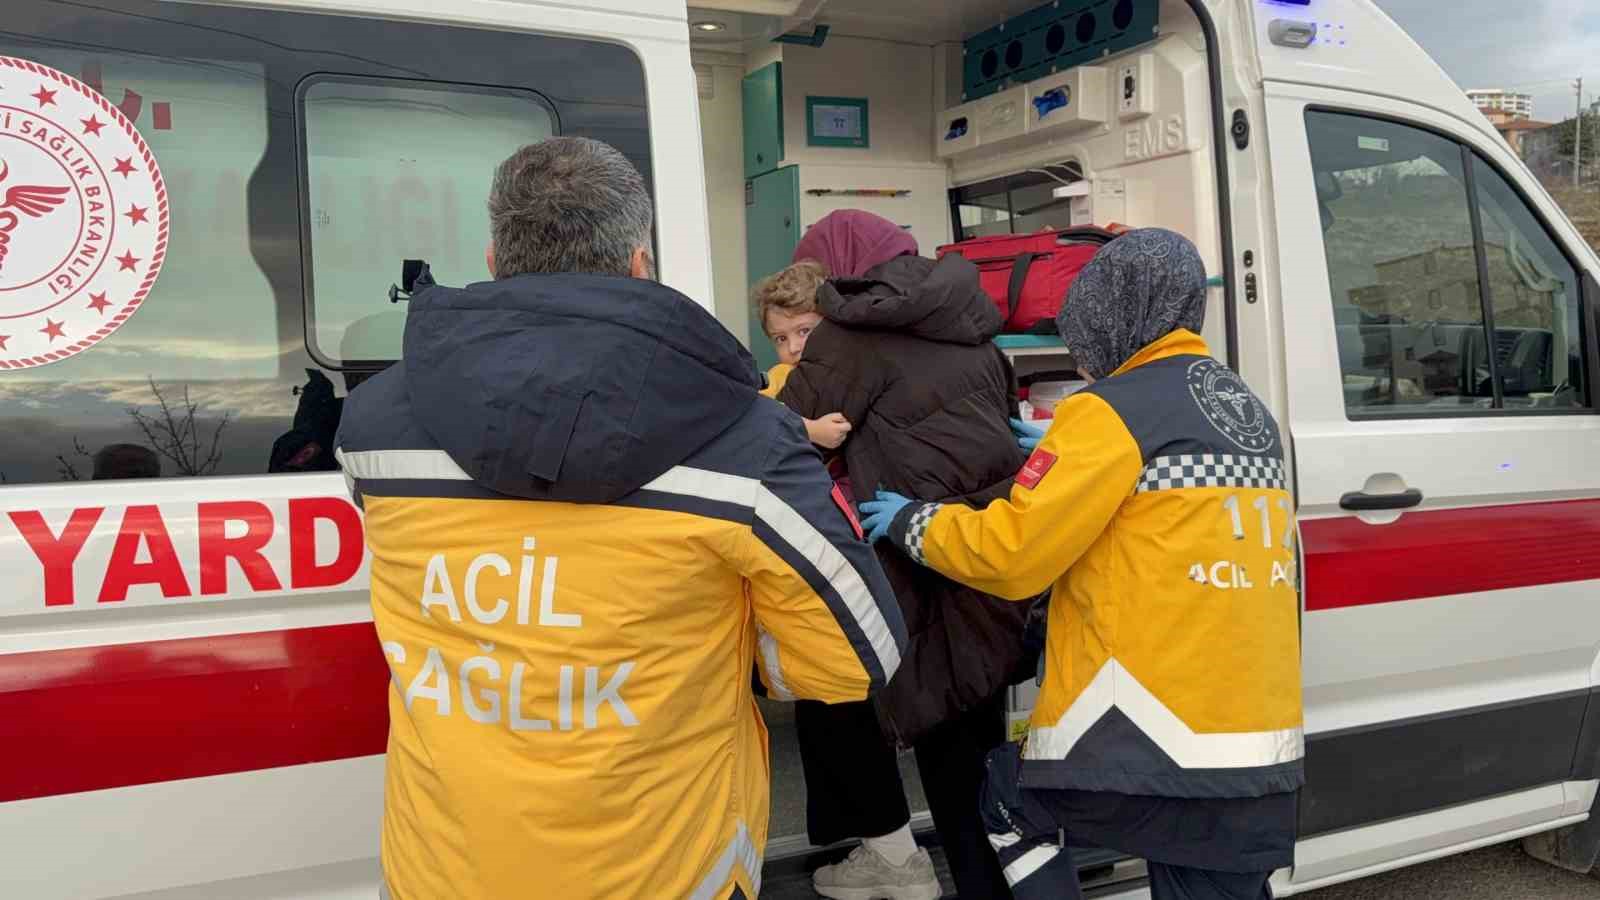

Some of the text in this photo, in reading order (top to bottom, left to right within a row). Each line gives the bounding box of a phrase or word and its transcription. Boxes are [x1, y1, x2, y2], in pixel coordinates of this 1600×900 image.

[19, 119, 94, 180] SAĞLIK
[1124, 114, 1184, 159] EMS
[48, 185, 105, 295] BAKANLIĞI
[420, 536, 582, 628] ACİL
